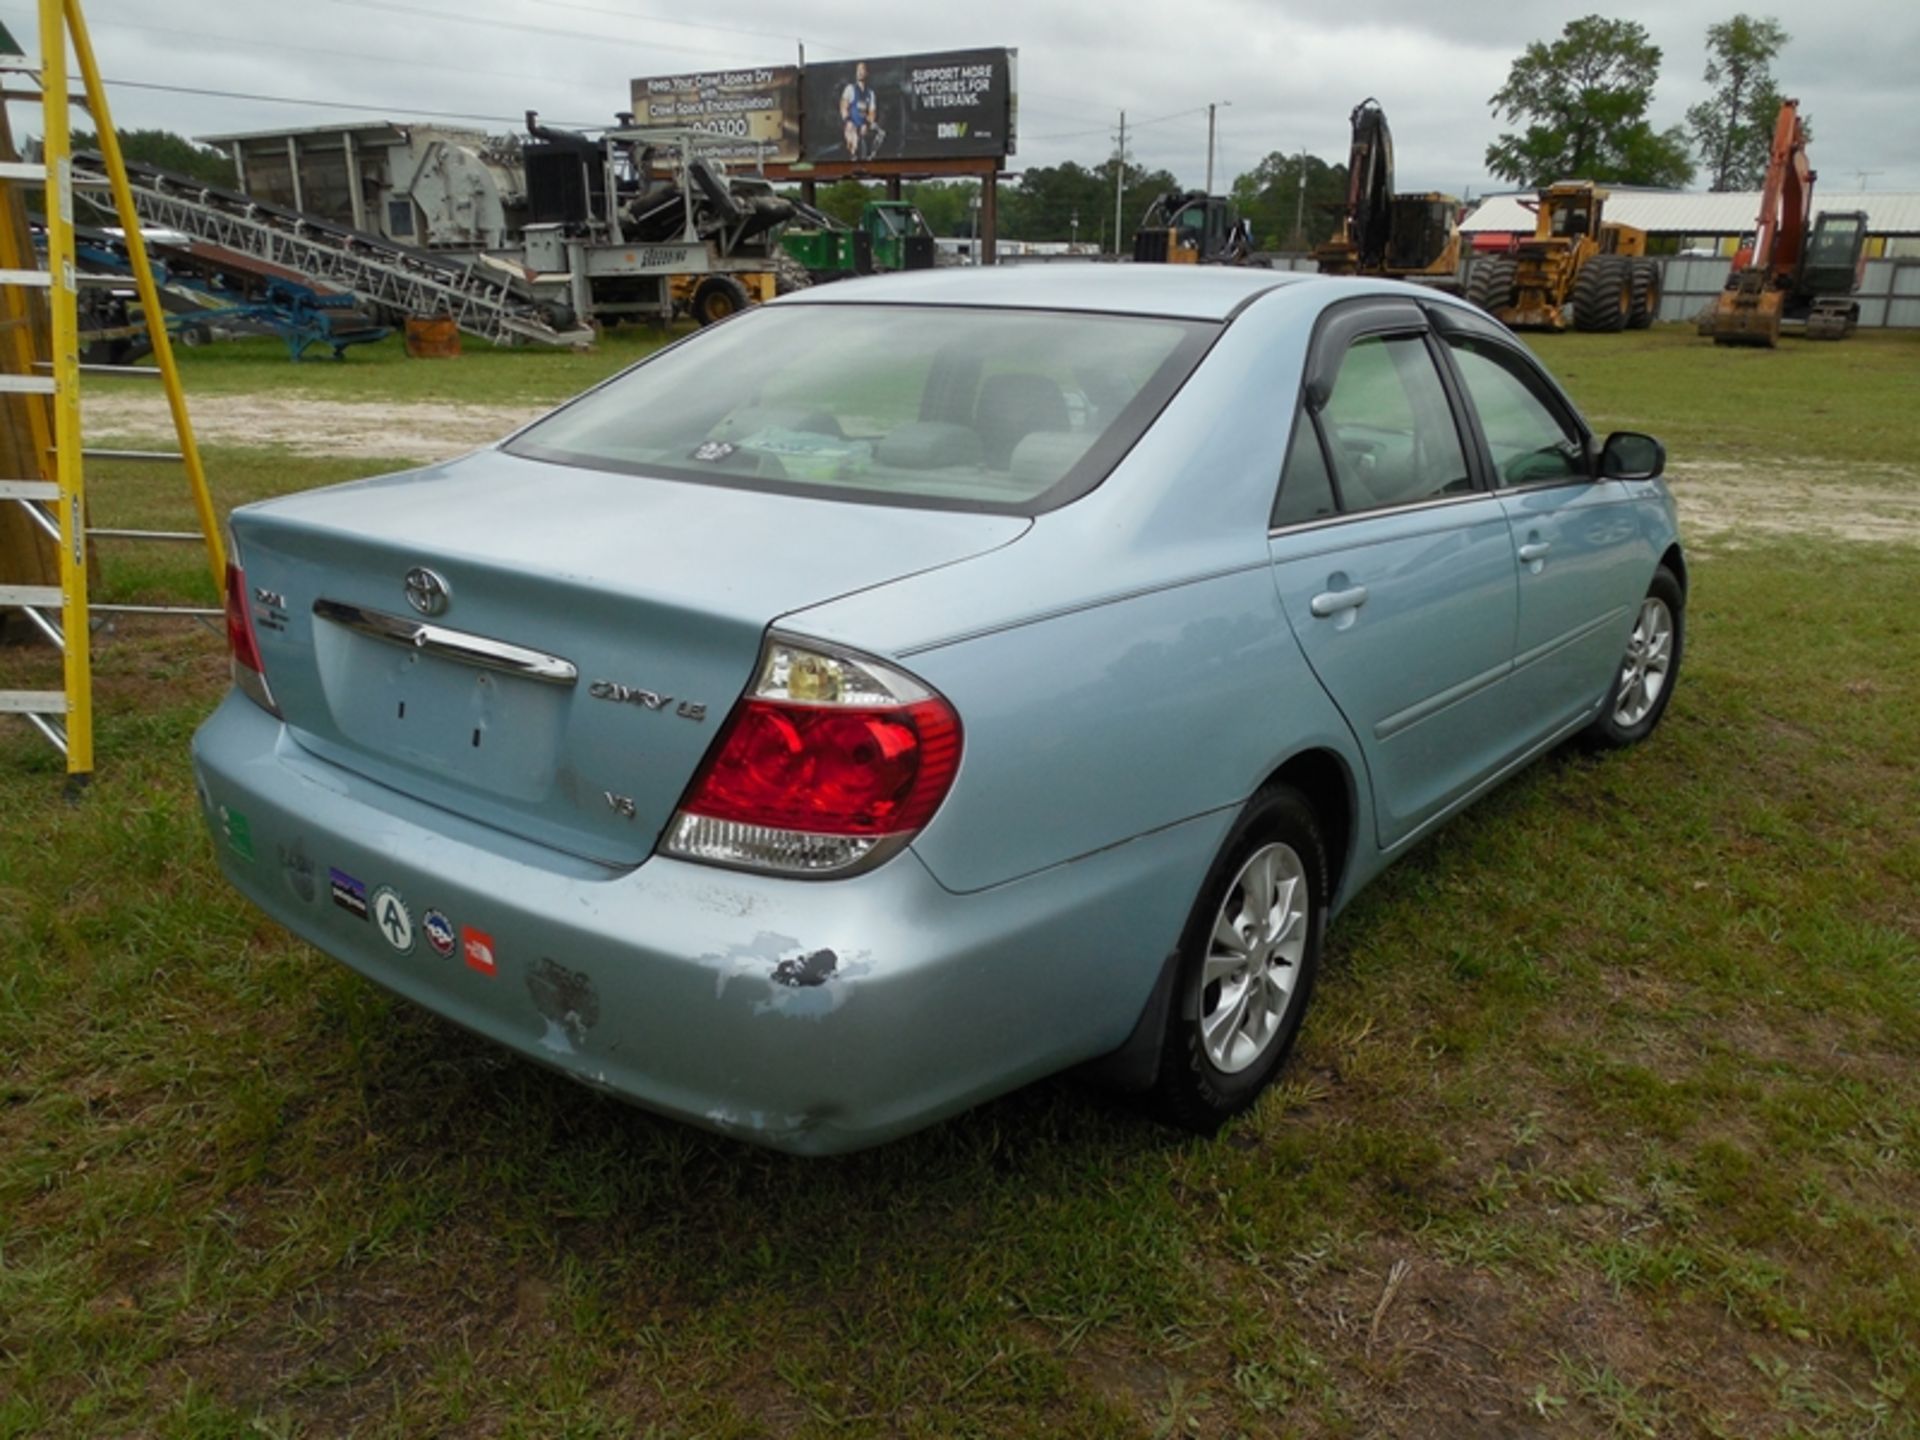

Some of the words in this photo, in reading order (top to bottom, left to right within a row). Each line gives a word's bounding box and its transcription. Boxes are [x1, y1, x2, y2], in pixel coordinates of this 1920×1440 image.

[696, 74, 720, 88] Crawl
[723, 72, 752, 86] Space
[755, 70, 774, 83] Dry
[912, 67, 960, 82] SUPPORT
[962, 64, 992, 78] MORE
[914, 80, 966, 95] VICTORIES
[969, 79, 990, 92] FOR
[650, 103, 675, 116] Crawl
[676, 102, 704, 115] Space
[707, 97, 774, 113] Encapsulation
[588, 679, 674, 711] CAMRY
[604, 791, 637, 819] V6
